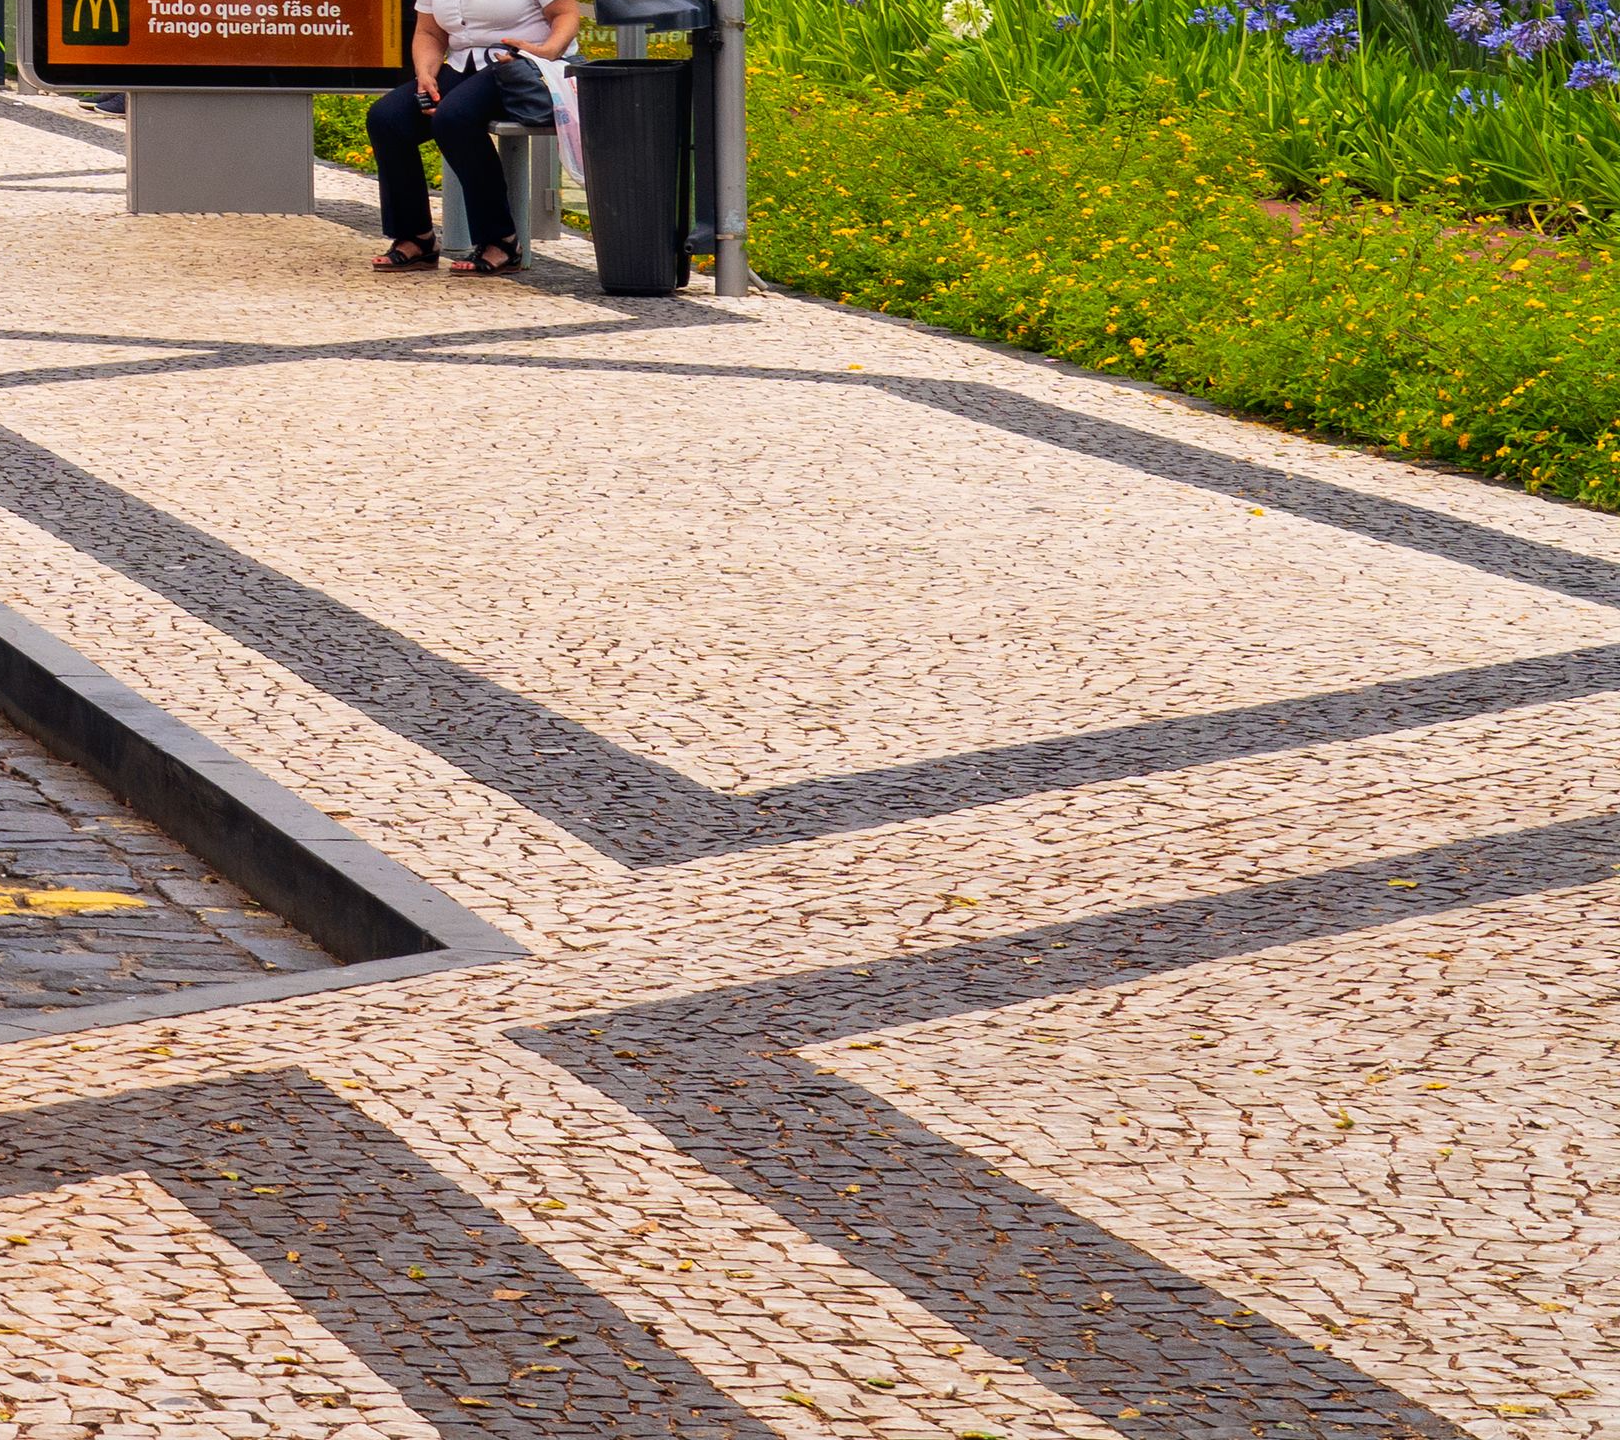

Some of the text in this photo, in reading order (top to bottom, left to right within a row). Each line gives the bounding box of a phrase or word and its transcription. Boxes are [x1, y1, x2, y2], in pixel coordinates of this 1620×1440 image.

[147, 0, 341, 19] Tudo o que os fãs de
[147, 17, 354, 38] frango queriam ouvir.
